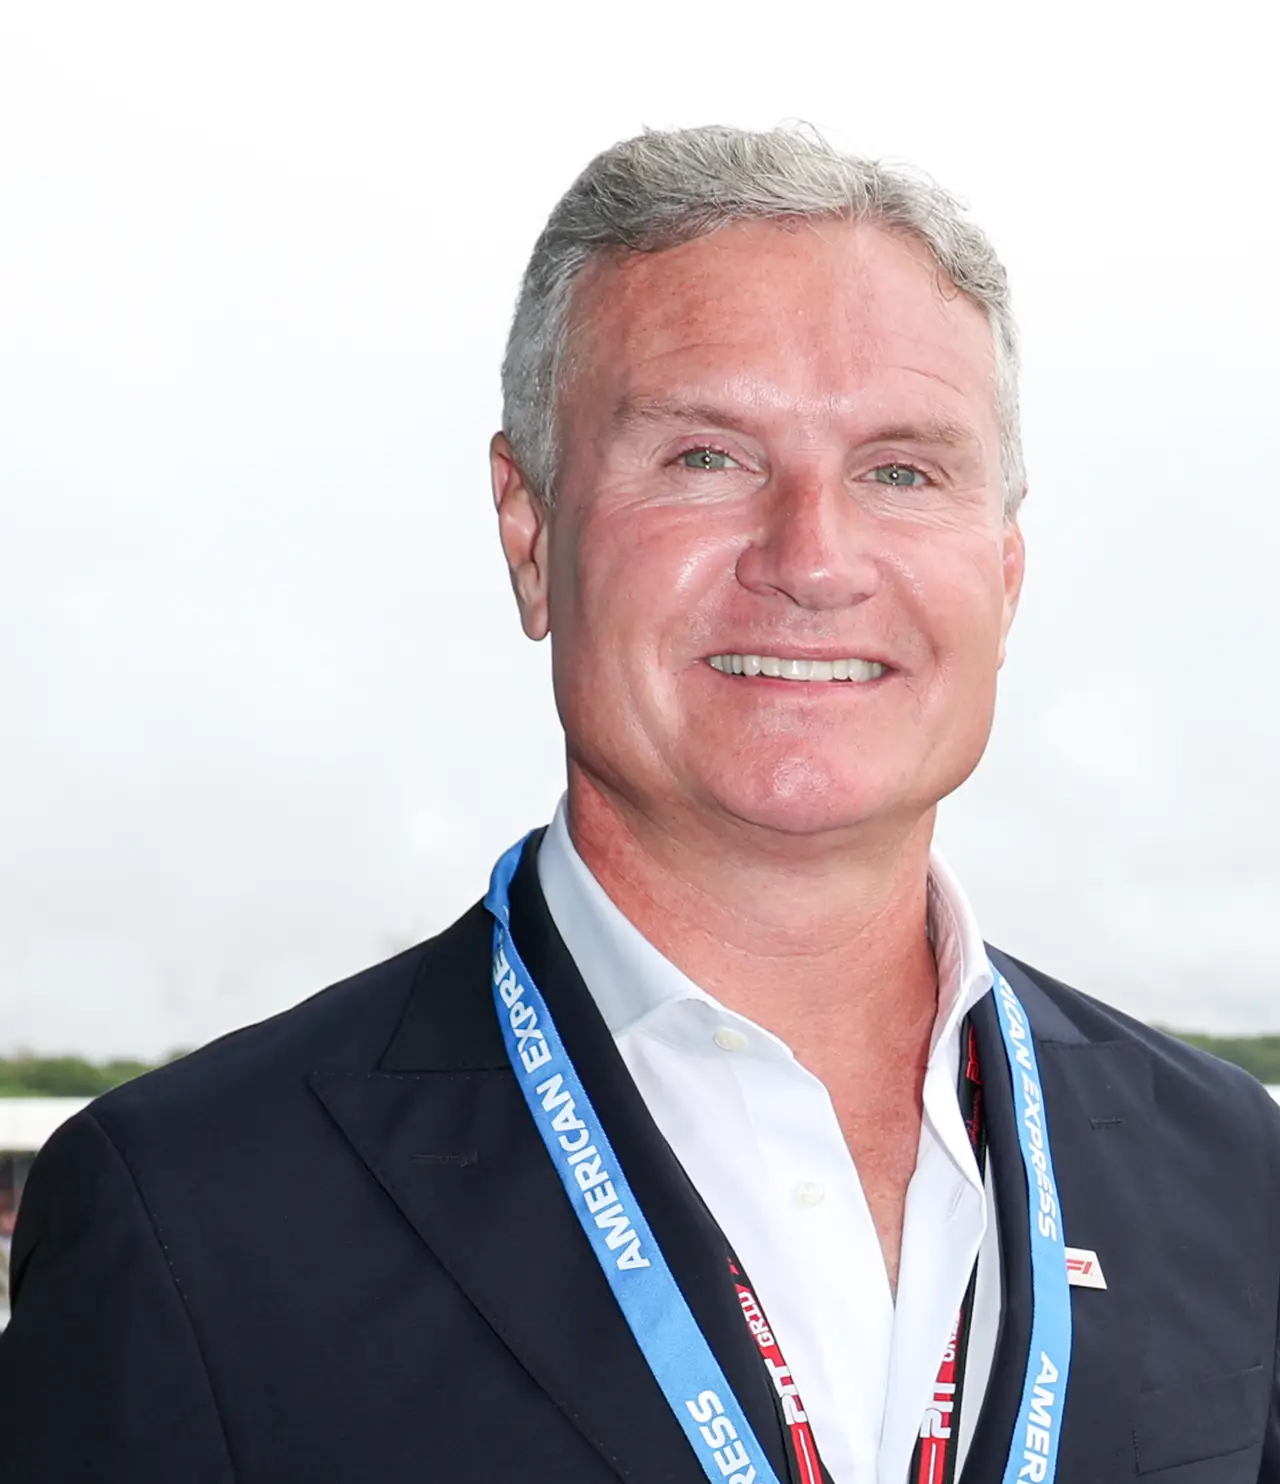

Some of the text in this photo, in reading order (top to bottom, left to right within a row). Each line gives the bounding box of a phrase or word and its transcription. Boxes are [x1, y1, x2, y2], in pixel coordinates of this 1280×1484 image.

[494, 930, 650, 1270] AMERICAN EXPRE
[1021, 1073, 1058, 1242] EXPRESS
